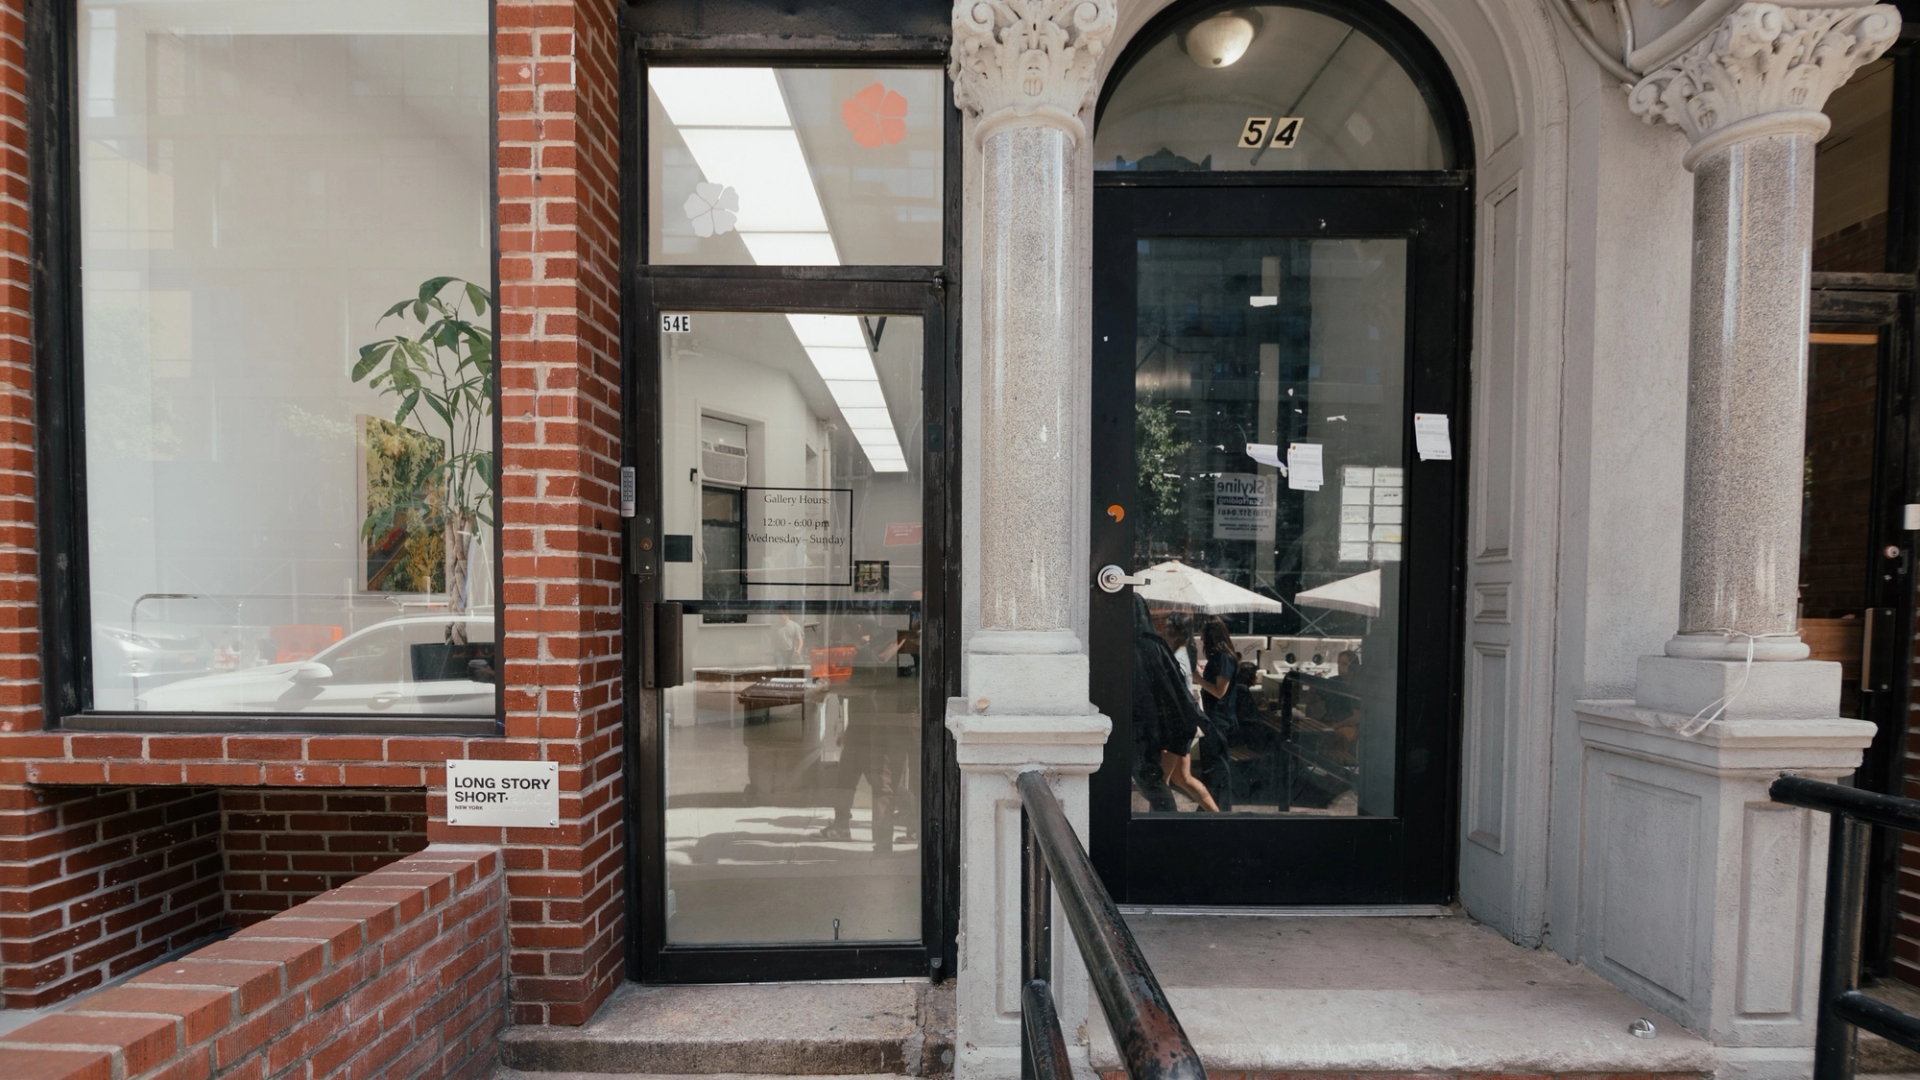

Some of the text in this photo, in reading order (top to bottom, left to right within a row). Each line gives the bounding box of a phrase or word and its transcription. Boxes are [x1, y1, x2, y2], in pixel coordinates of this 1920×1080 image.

[1244, 120, 1299, 146] 54
[663, 315, 689, 332] 54E
[764, 494, 830, 506] Gallery Hours:
[763, 518, 786, 527] 12:00
[794, 518, 813, 527] 6:00
[815, 520, 830, 530] pm
[747, 533, 802, 546] Wednesday
[810, 534, 846, 546] Sunday
[454, 777, 551, 790] LONG STORY
